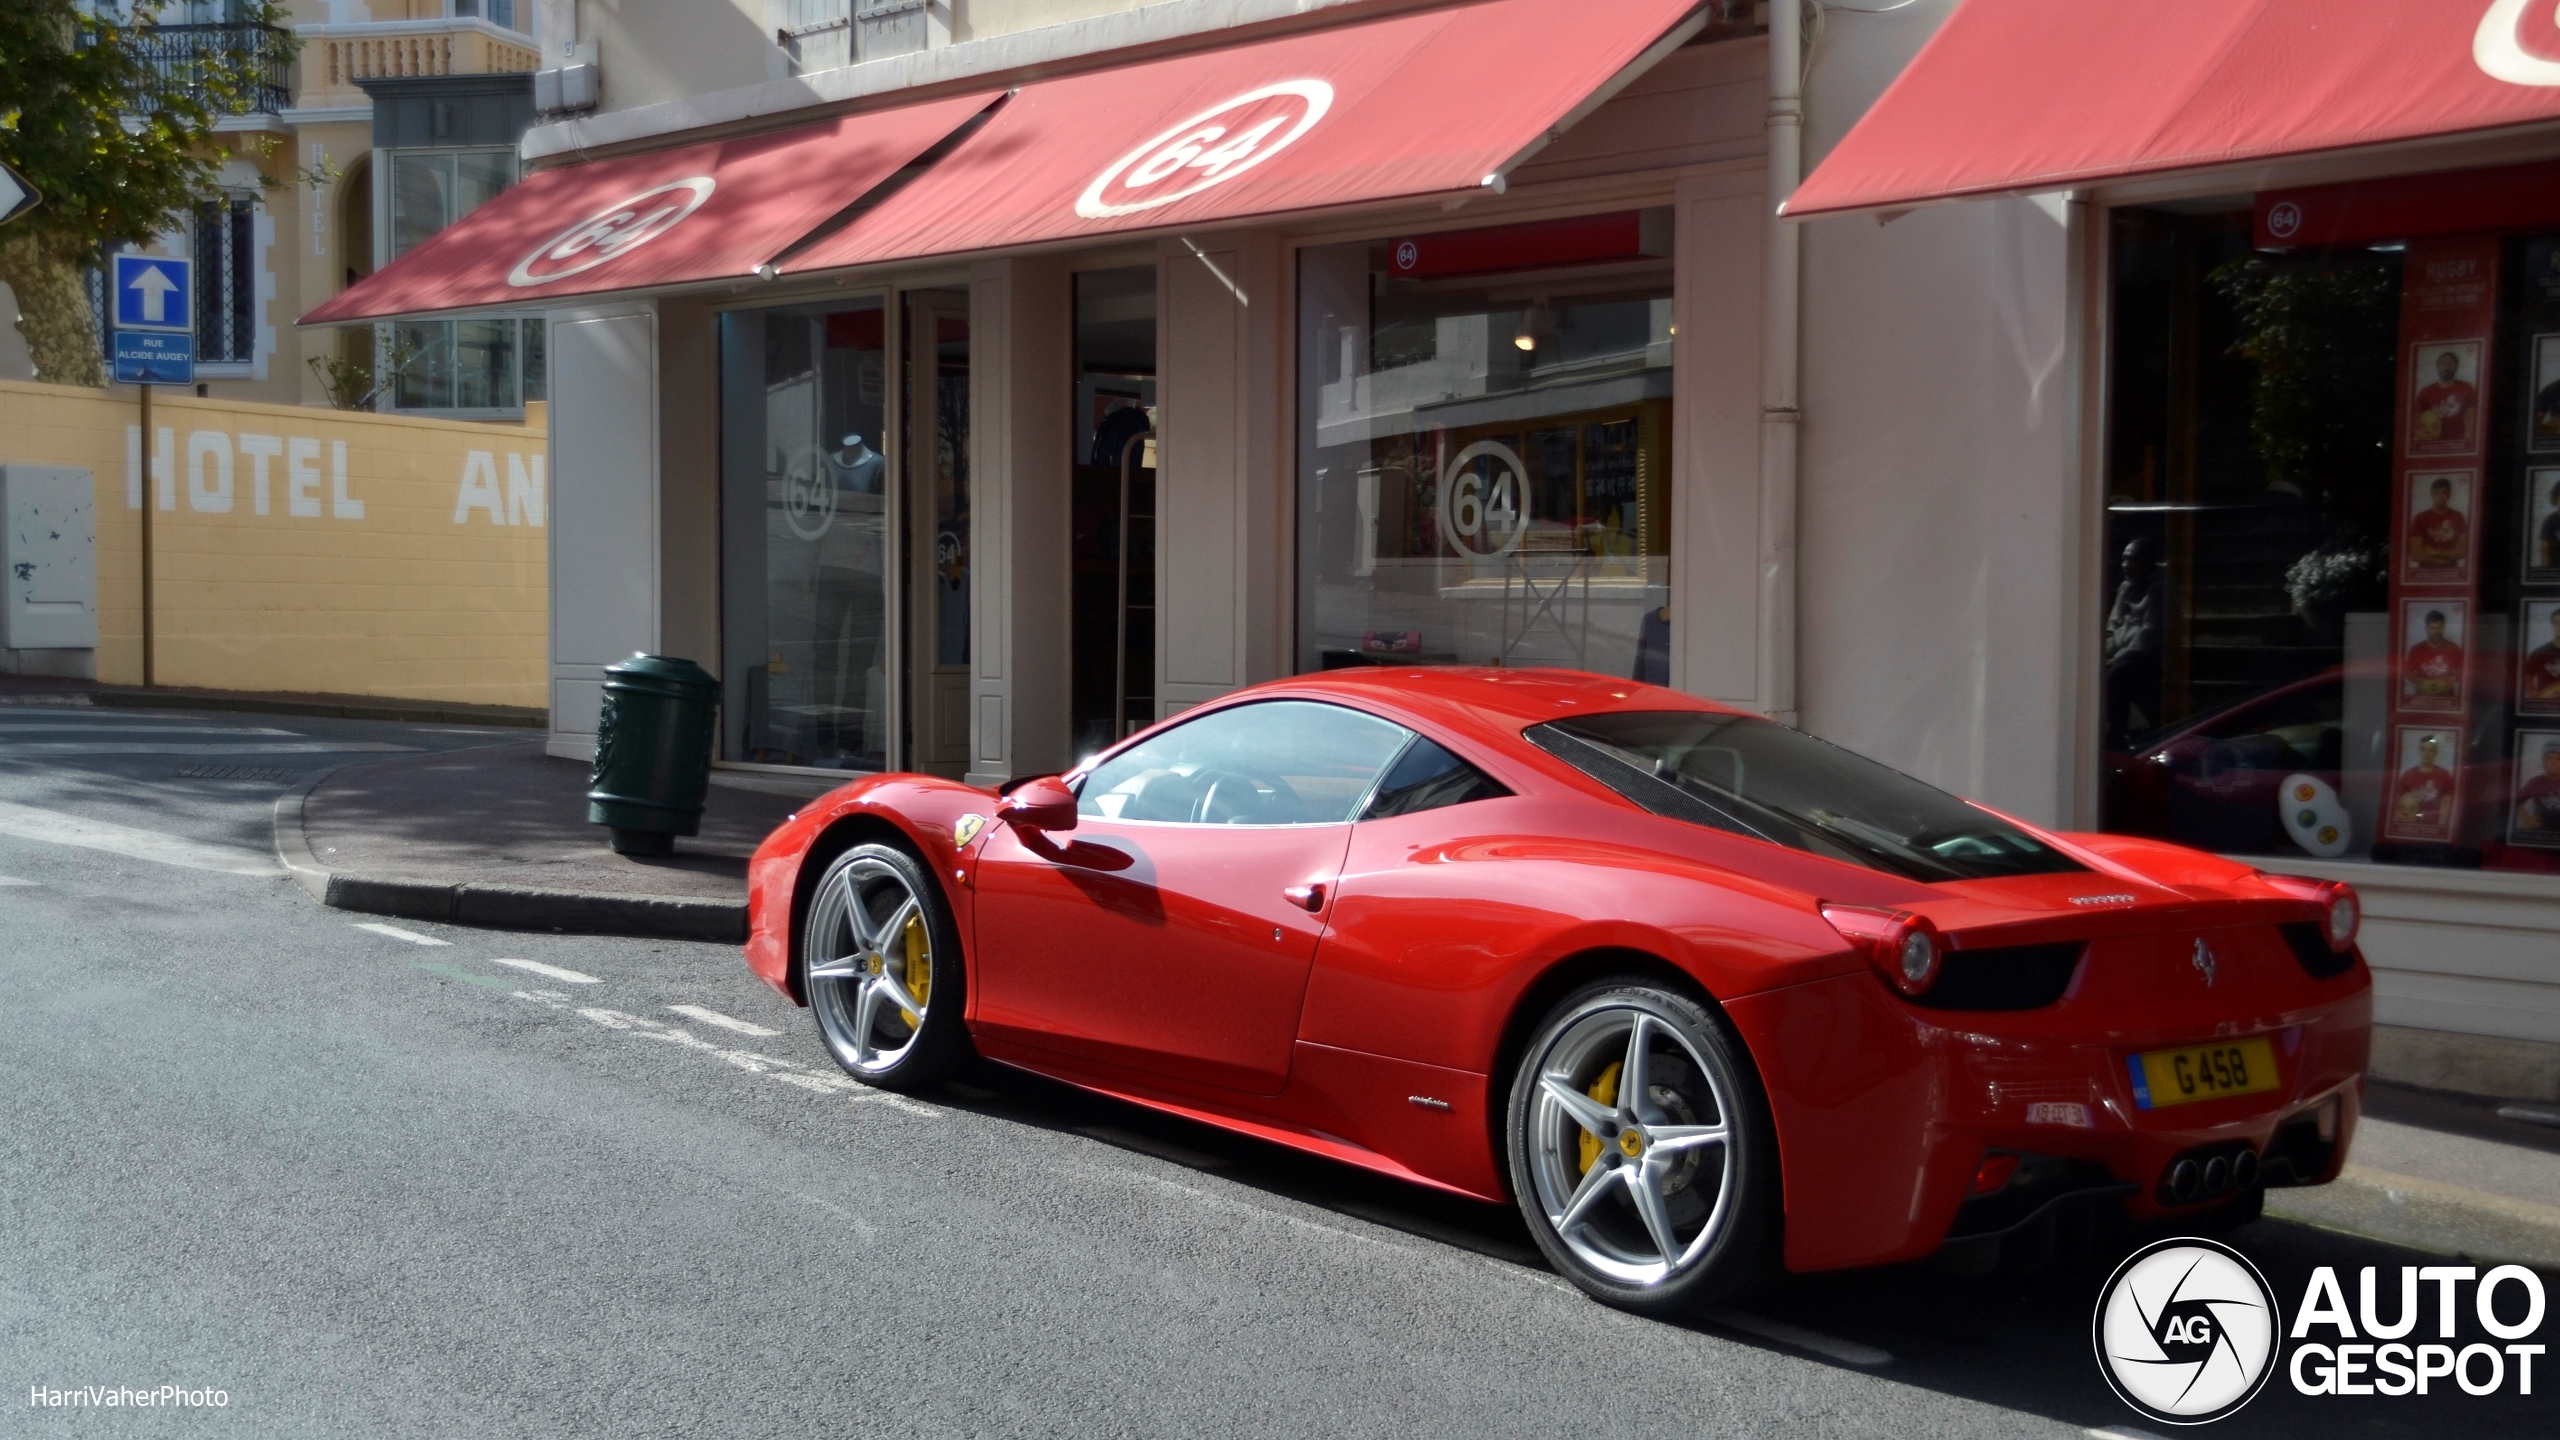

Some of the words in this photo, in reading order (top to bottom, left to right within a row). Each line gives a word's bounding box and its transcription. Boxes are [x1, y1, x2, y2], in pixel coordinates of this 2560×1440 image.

[1125, 115, 1290, 188] 64
[311, 143, 326, 256] HOTEL
[550, 206, 679, 260] 64
[118, 351, 154, 360] ALCIDE
[156, 352, 190, 361] AUGEY
[143, 339, 165, 348] RUE
[127, 425, 366, 520] HOTEL
[453, 450, 548, 528] AN
[790, 466, 829, 518] 64
[1453, 471, 1516, 537] 64
[938, 543, 955, 565] 64
[2174, 1055, 2195, 1095] G
[2200, 1047, 2248, 1092] 458
